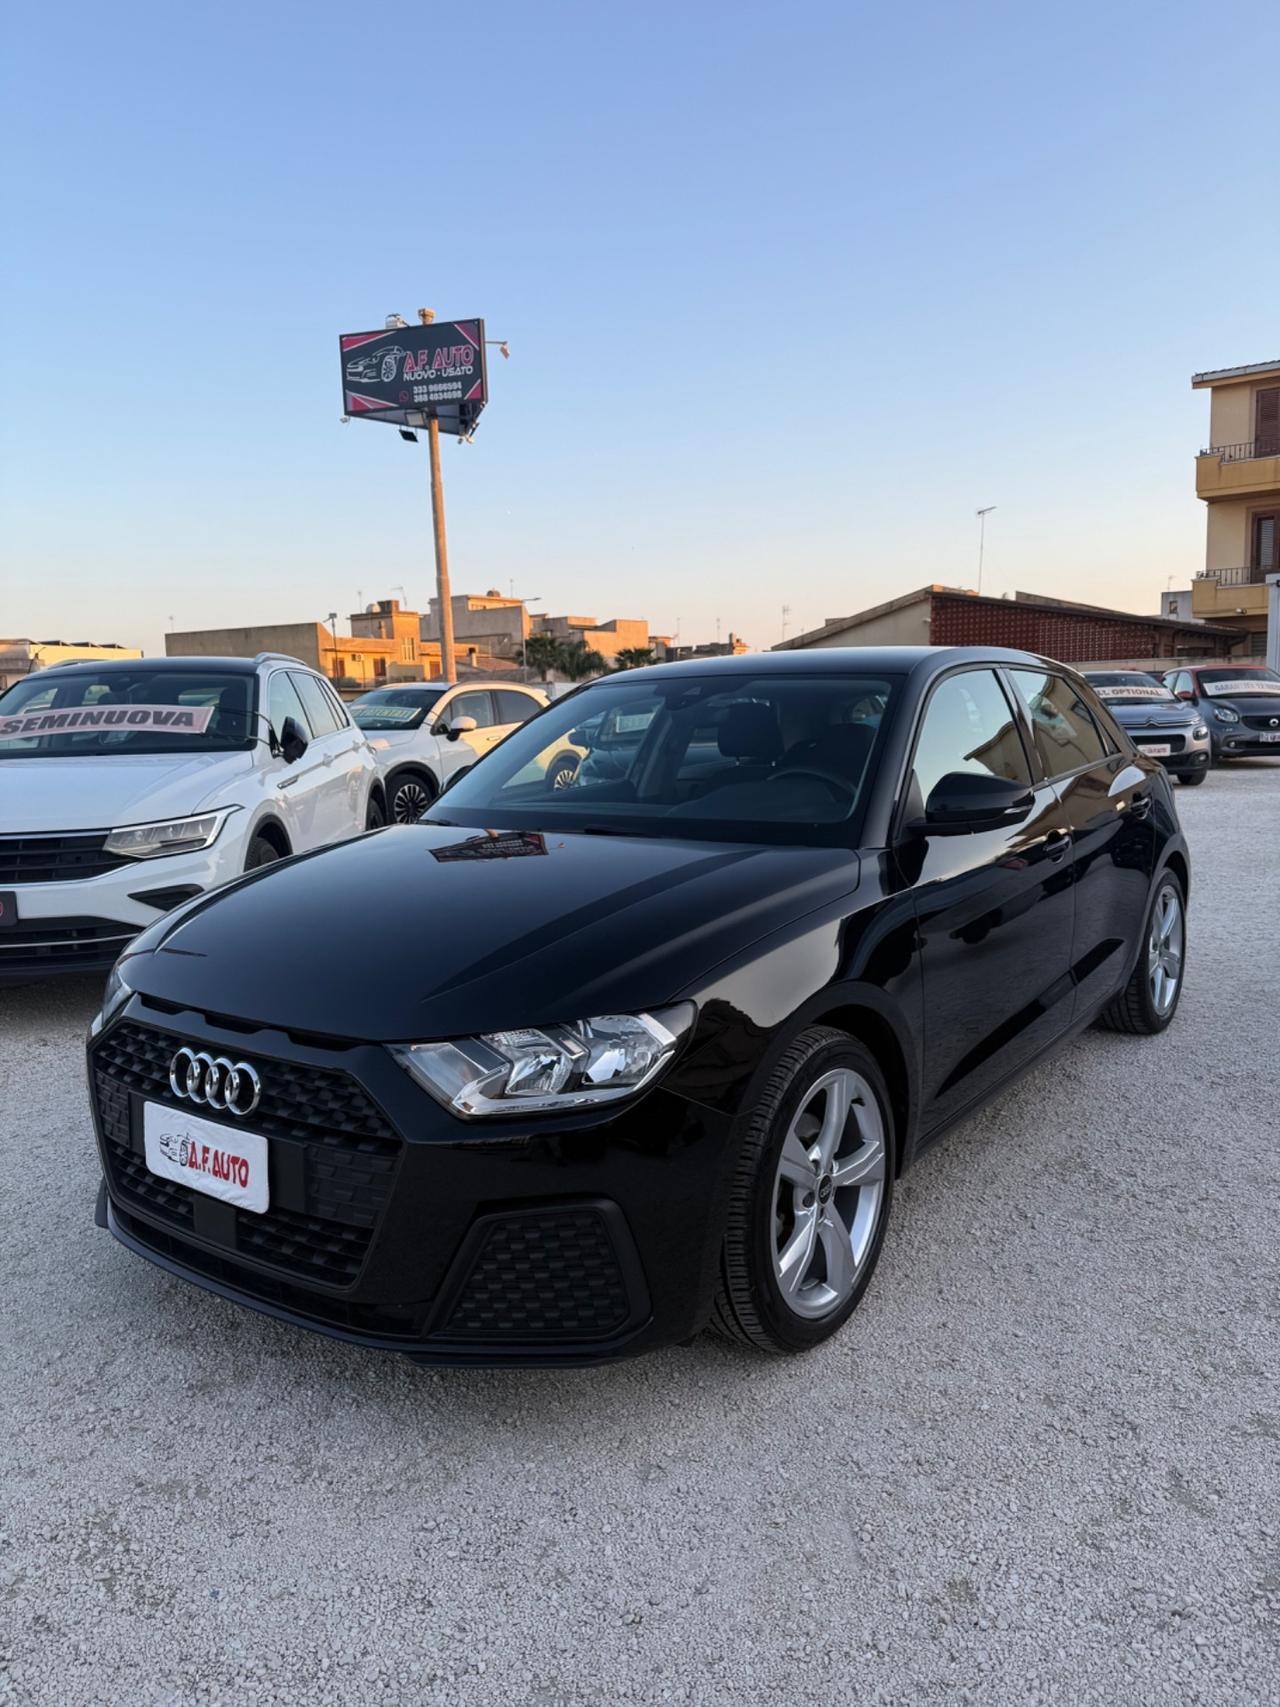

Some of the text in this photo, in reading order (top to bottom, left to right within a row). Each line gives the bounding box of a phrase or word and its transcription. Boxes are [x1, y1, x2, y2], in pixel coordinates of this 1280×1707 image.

[432, 344, 474, 369] AUTO
[403, 366, 473, 381] NUOVO USATO
[1112, 688, 1162, 697] OPTIONAL
[0, 709, 194, 734] SEMINUOVA
